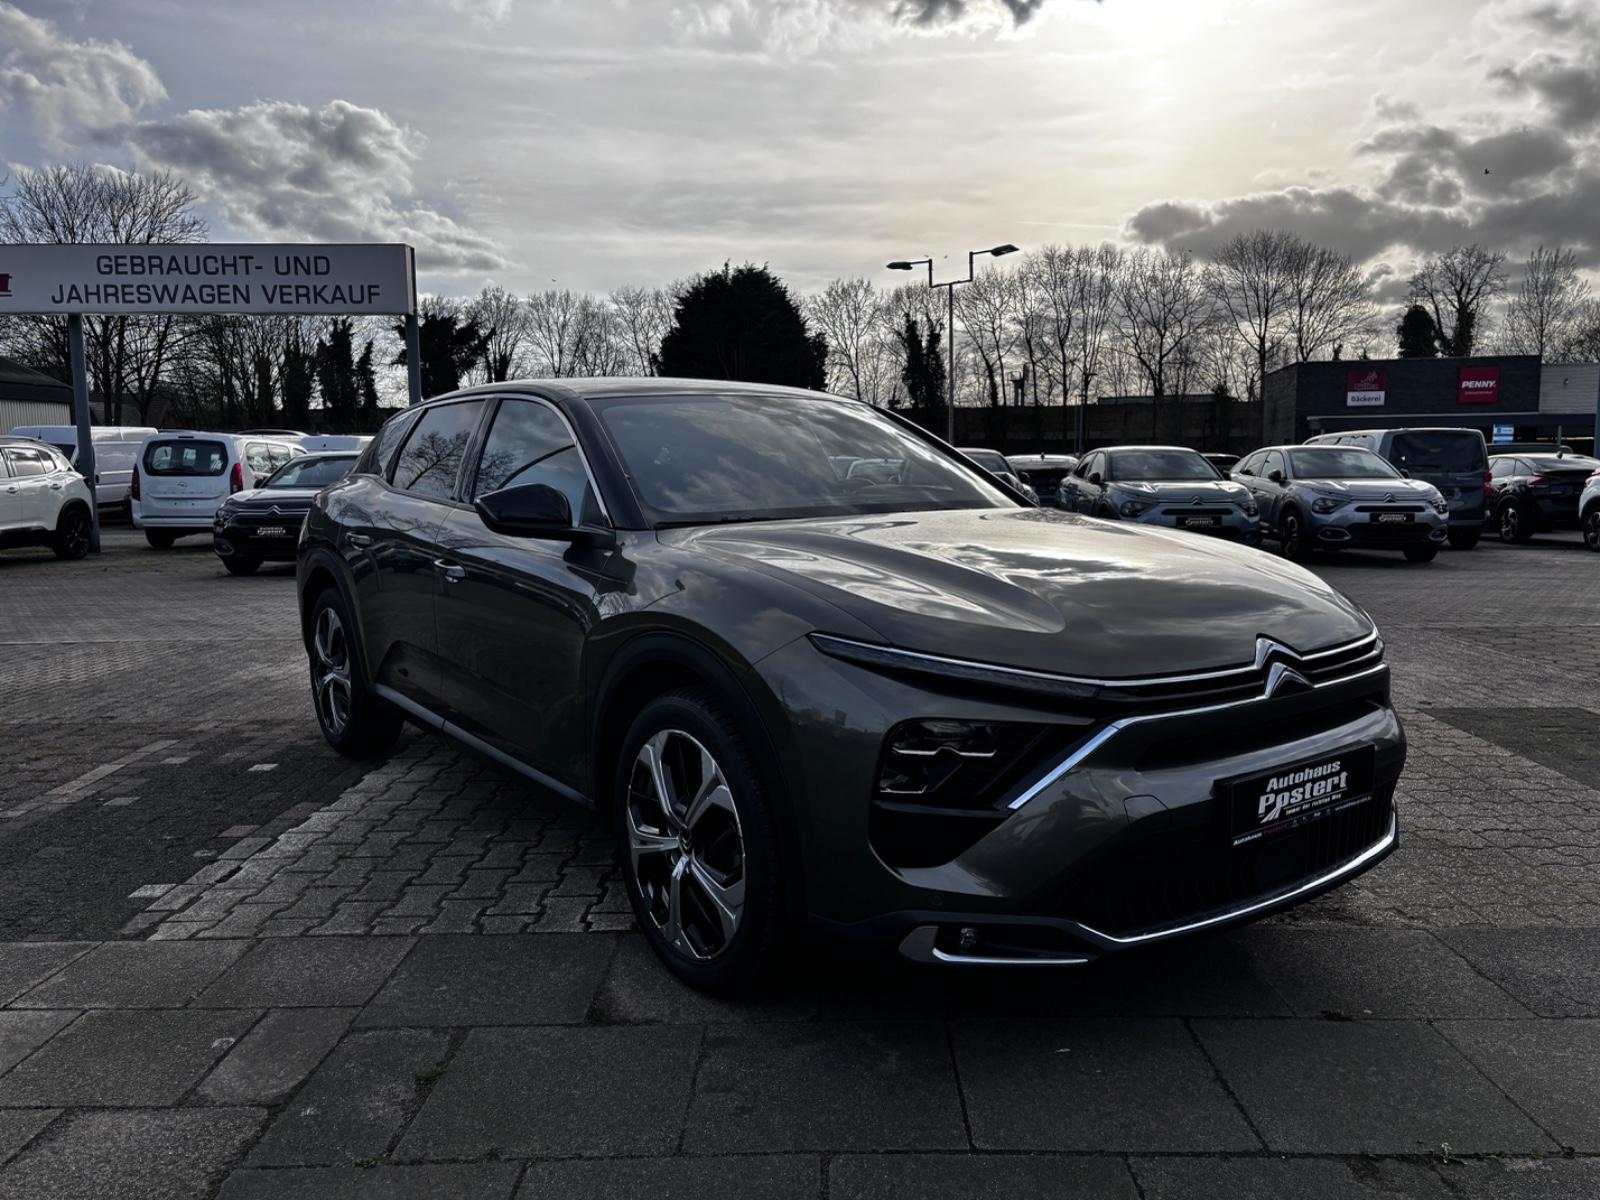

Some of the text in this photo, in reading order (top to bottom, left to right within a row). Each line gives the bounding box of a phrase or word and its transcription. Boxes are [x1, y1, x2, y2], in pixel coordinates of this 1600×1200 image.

[96, 255, 331, 276] GEBRAUCHT- UND
[51, 284, 381, 305] JAHRESWAGEN VERKAUF
[1351, 394, 1381, 402] Bäckerei
[1266, 761, 1341, 792] Autohaus
[1257, 771, 1349, 824] Postert
